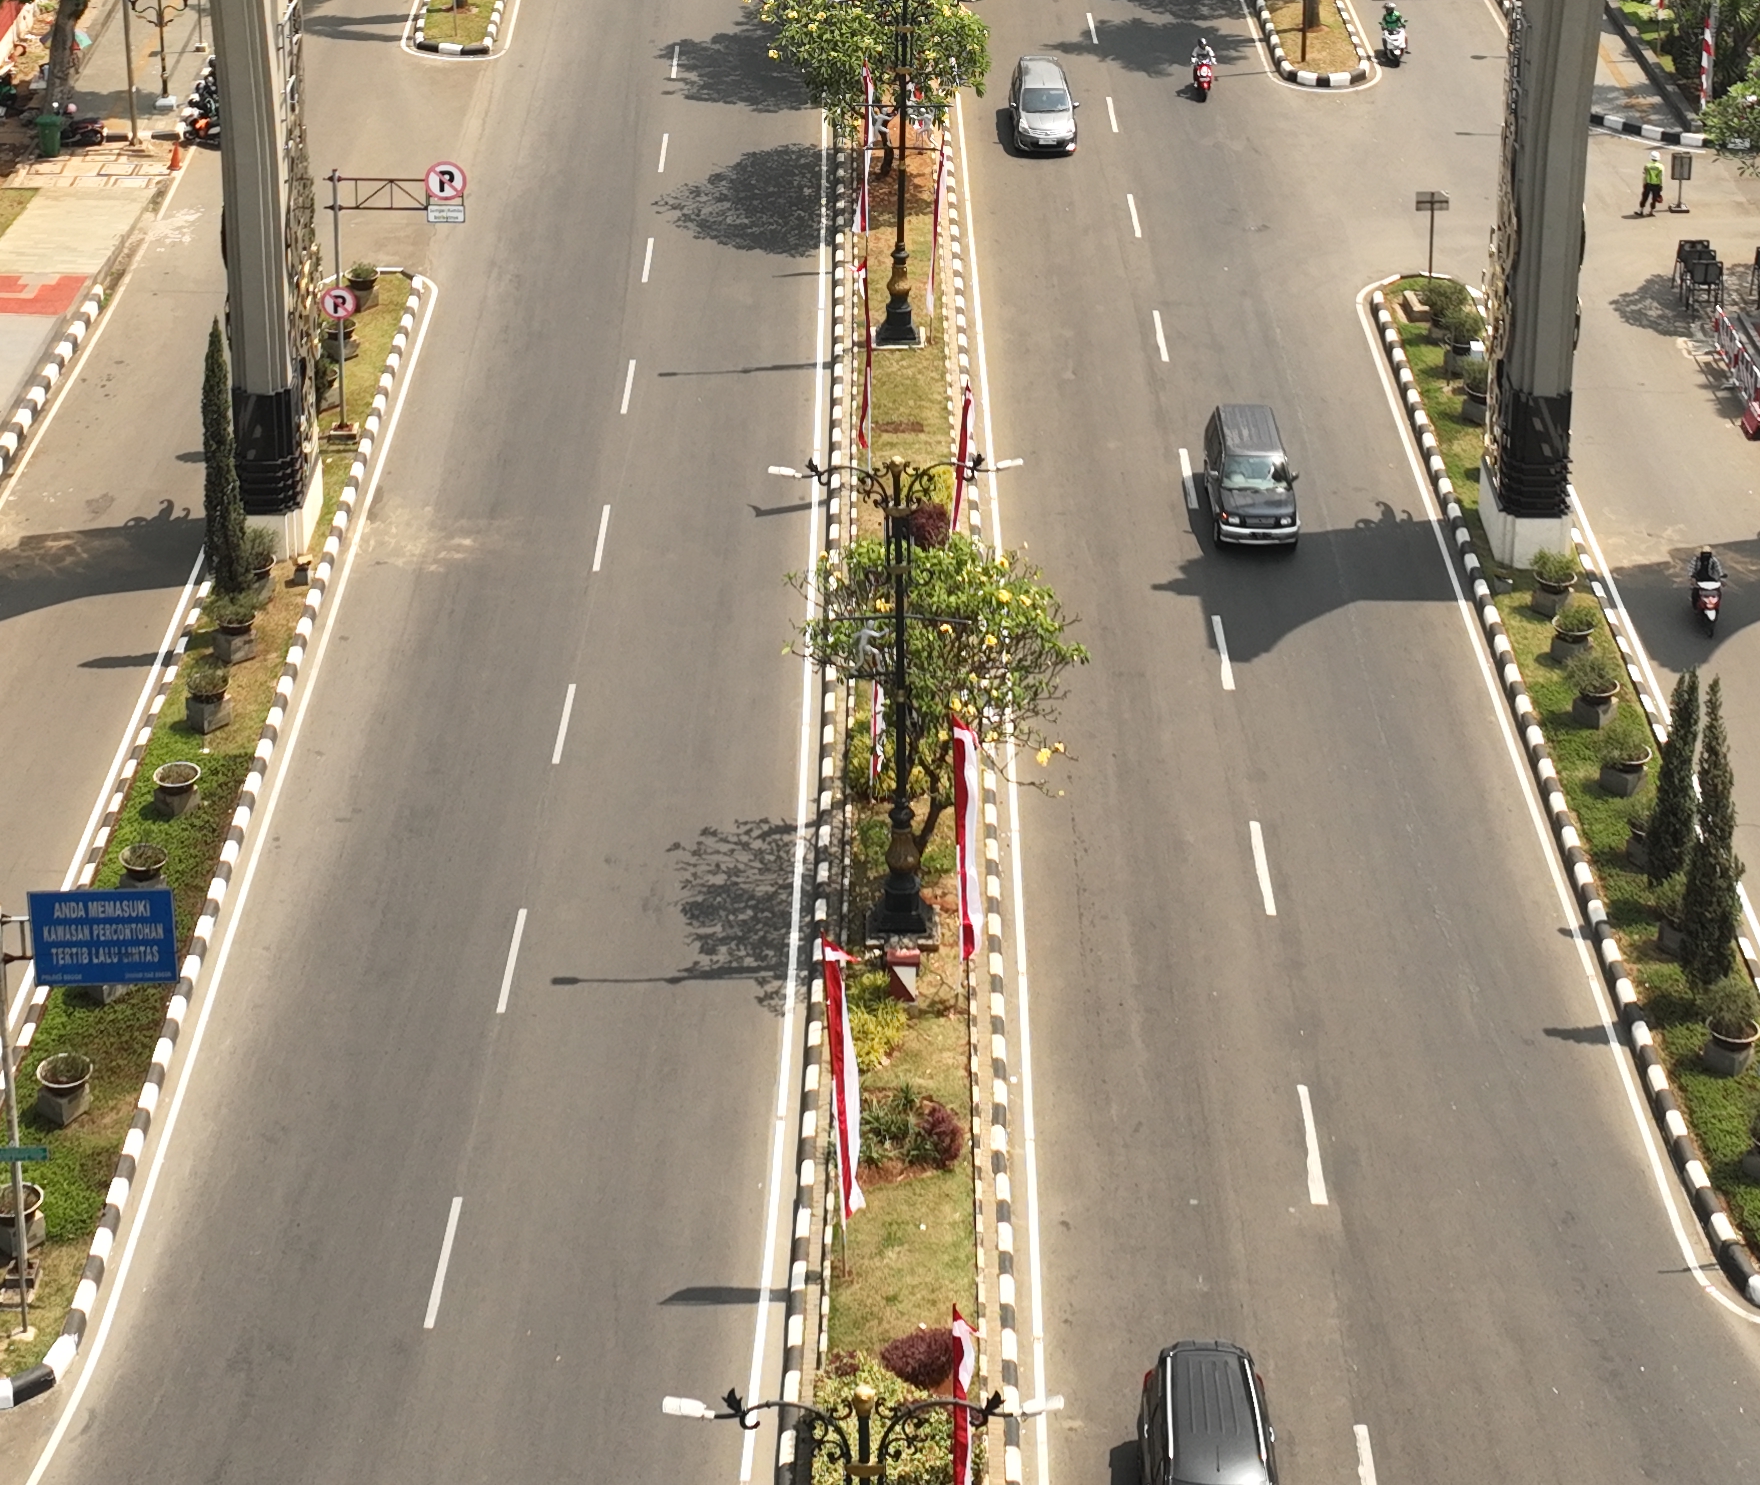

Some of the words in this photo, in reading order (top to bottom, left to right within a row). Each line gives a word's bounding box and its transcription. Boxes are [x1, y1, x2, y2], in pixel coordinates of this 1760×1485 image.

[54, 901, 85, 918] ANDA
[88, 899, 150, 917] MEMASUKI
[43, 925, 90, 942] KAWASAN
[93, 923, 164, 941] PERCONTOHAN
[51, 947, 89, 965] TERTIB
[92, 946, 119, 964] LALU
[122, 945, 159, 963] LINTAS
